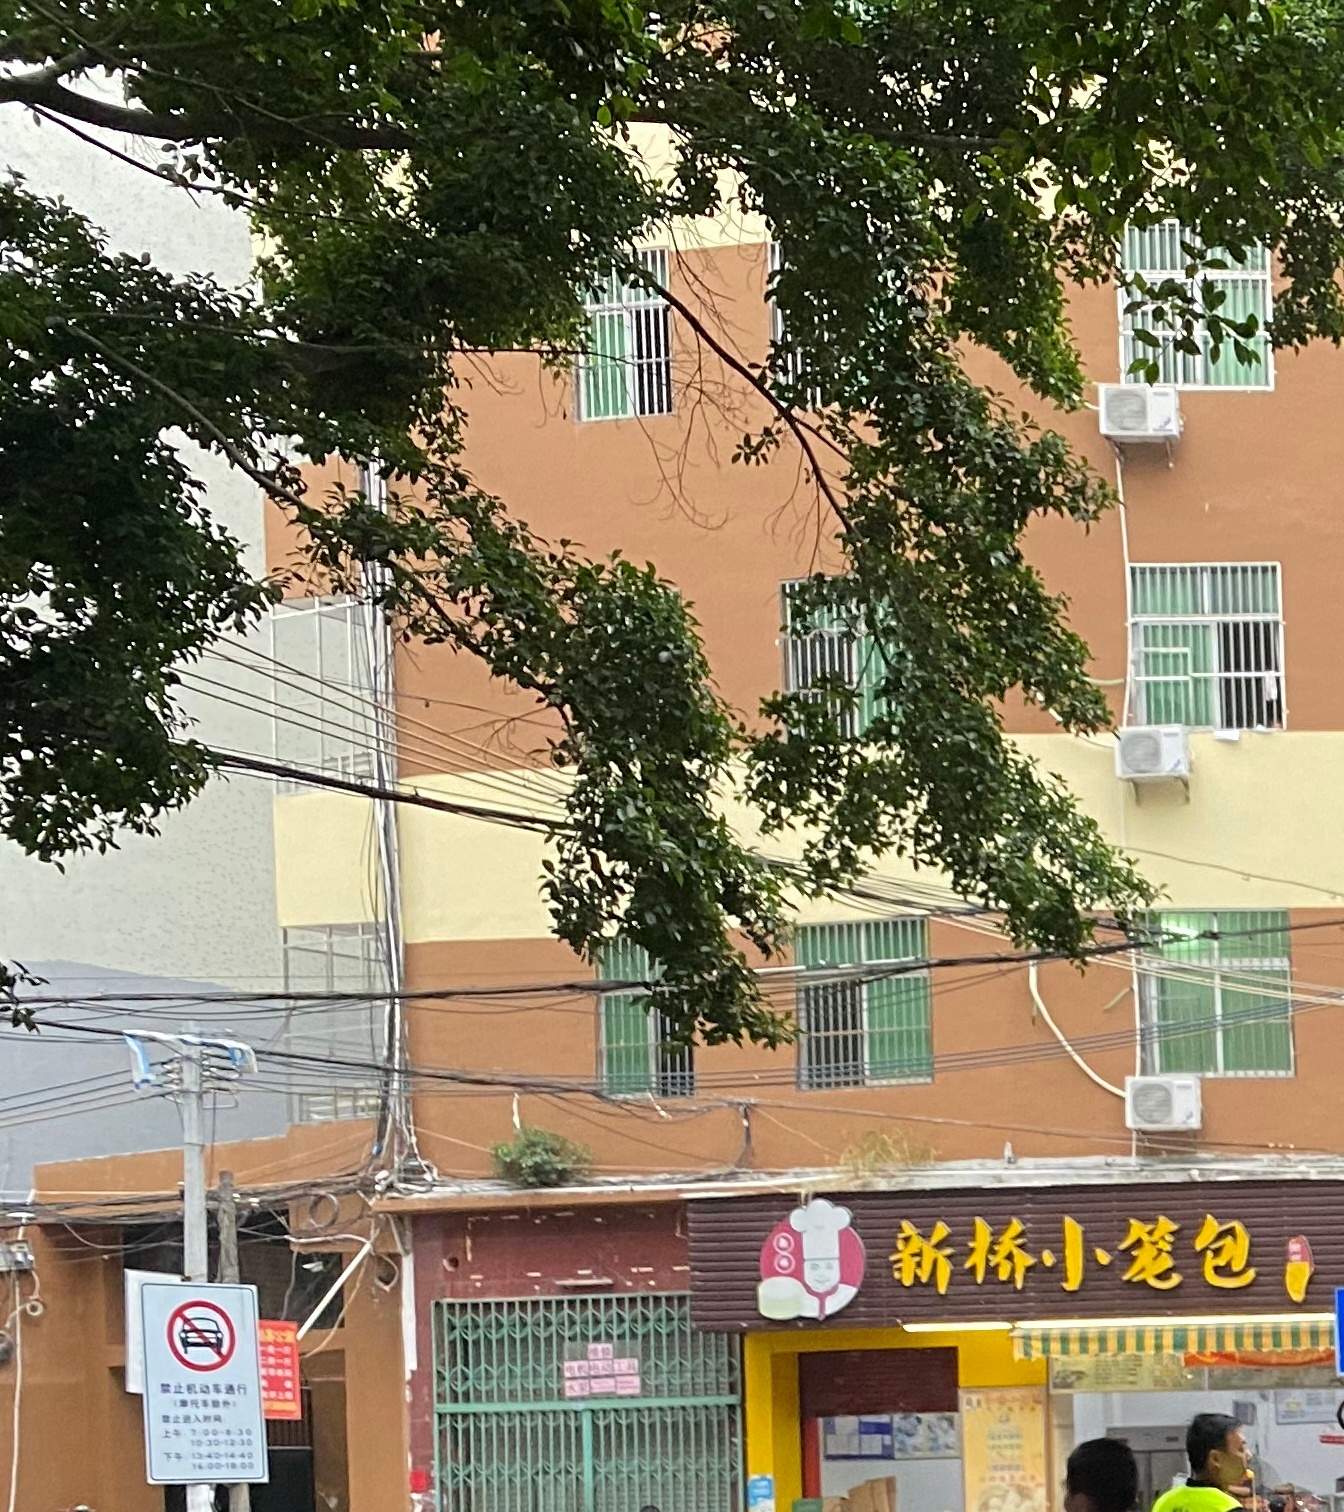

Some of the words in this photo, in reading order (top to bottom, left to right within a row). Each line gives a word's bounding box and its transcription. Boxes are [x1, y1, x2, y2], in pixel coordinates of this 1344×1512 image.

[890, 1213, 1258, 1296] 新桥小笼包
